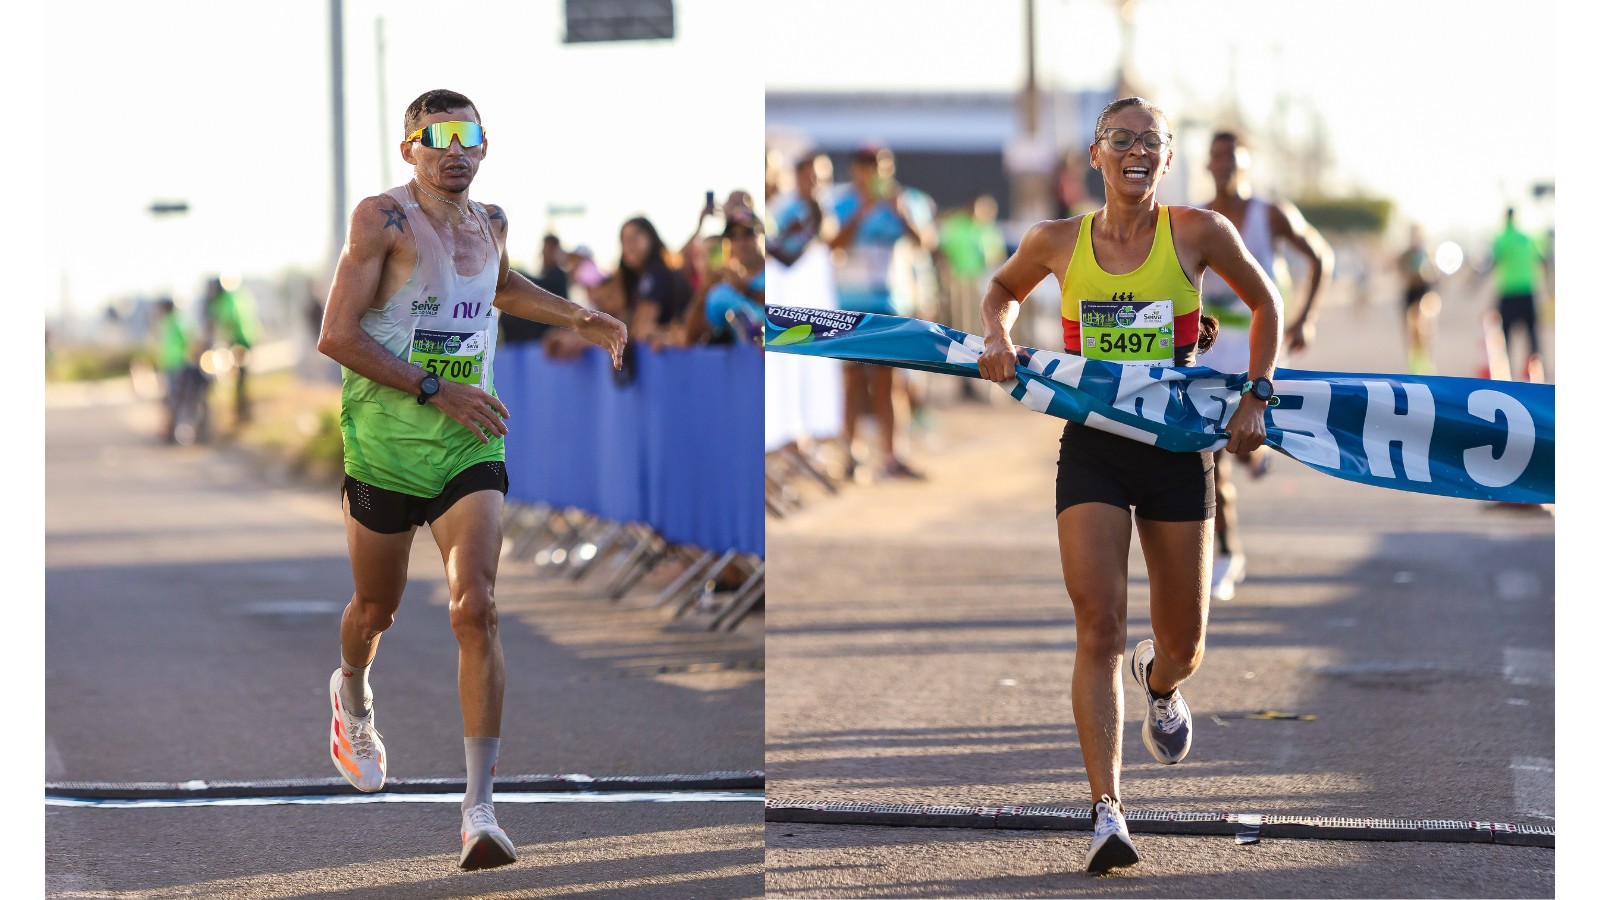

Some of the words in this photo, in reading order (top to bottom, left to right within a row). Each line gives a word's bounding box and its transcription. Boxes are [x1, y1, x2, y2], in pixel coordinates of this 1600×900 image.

[411, 301, 439, 312] Seiva
[768, 307, 809, 323] RÚSTICA
[809, 315, 853, 331] CORRIDA
[1099, 333, 1157, 353] 5497
[426, 359, 472, 378] 5700
